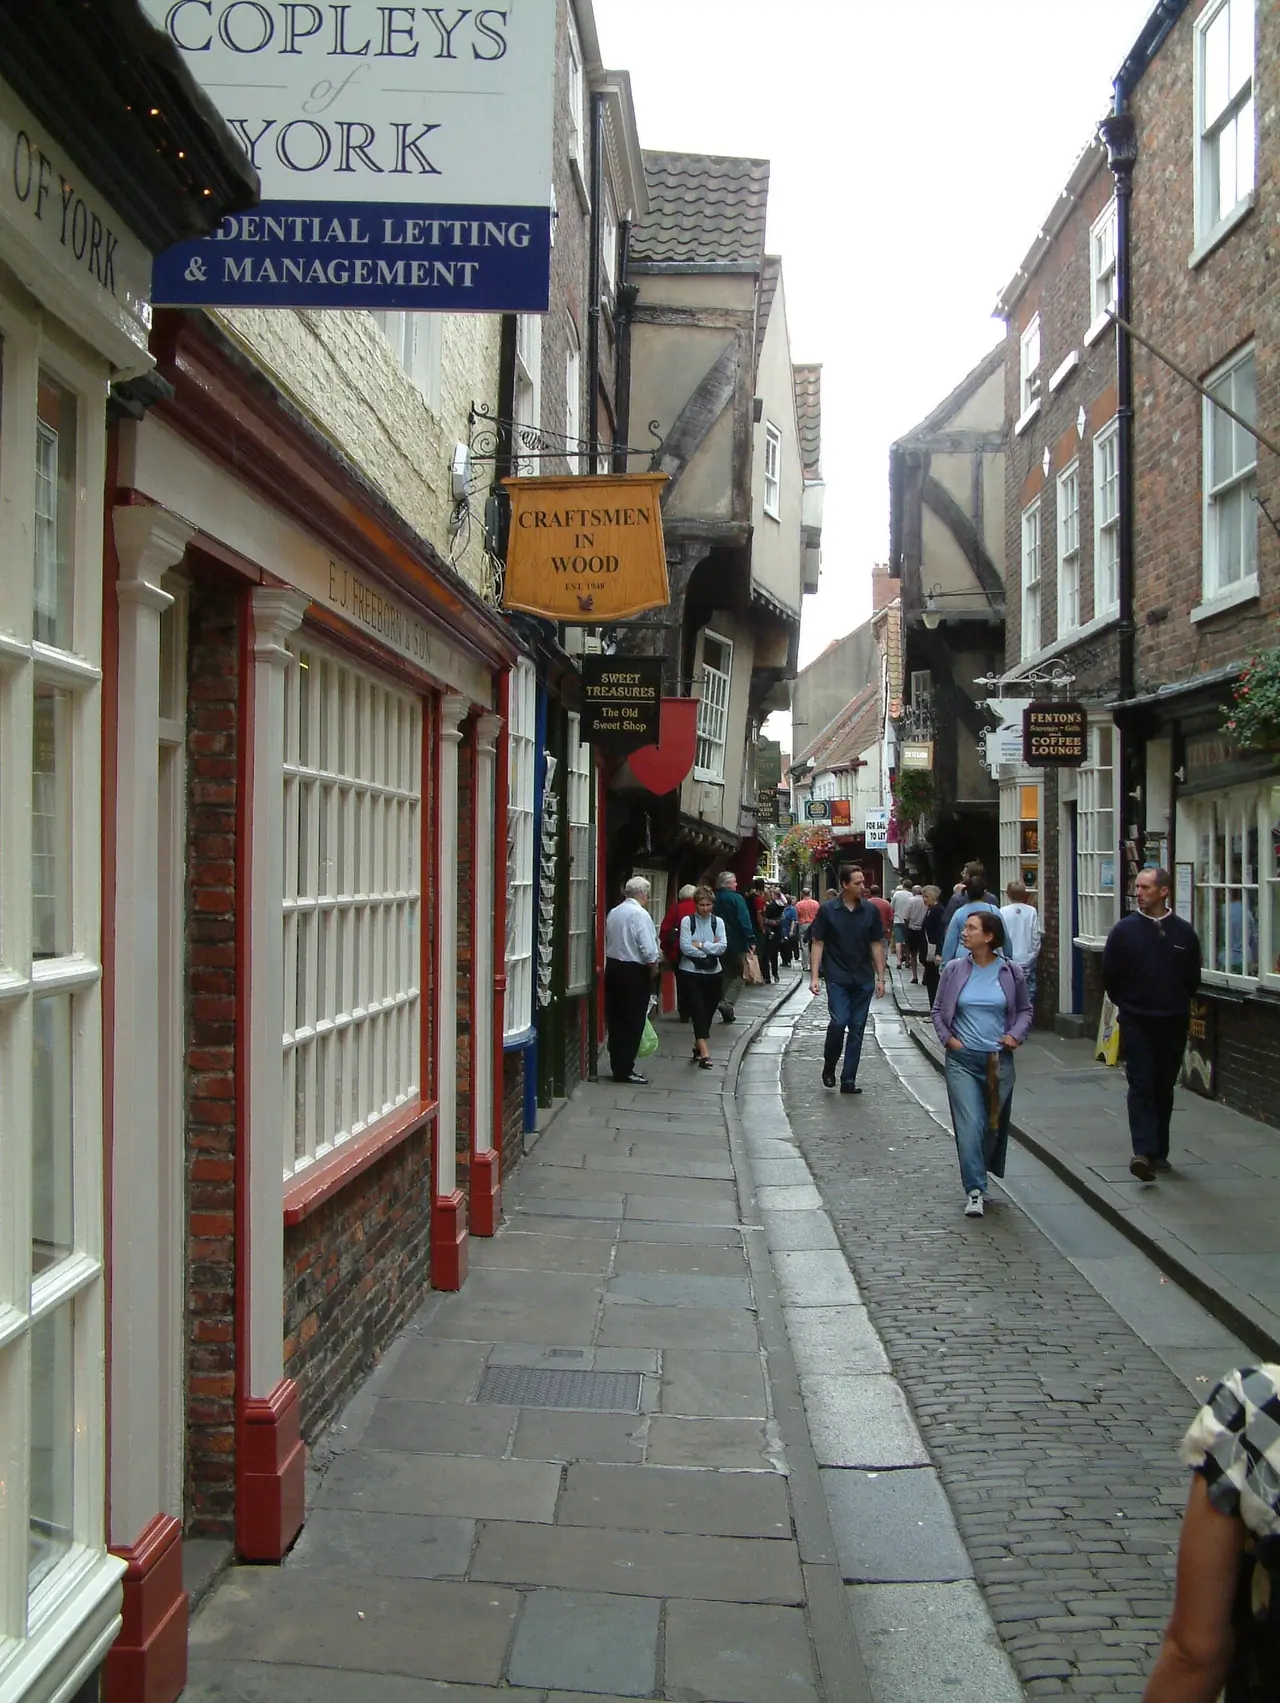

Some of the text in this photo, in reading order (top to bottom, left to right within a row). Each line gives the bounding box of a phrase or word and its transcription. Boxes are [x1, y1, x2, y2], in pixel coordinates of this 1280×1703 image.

[165, 0, 507, 60] COPLEYS
[302, 63, 371, 114] of
[226, 119, 442, 174] YORK
[14, 130, 118, 298] OF YORK
[203, 216, 532, 247] DENTIAL LETTING
[184, 256, 479, 287] & MANAGEMENT
[518, 508, 650, 528] CRAFTSMEN
[574, 533, 594, 548] IN
[551, 555, 619, 573] WOOD
[601, 673, 641, 684] SWEET
[586, 686, 655, 697] TREASURES
[602, 707, 638, 718] The Old
[1030, 712, 1082, 723] FENTON'S
[593, 720, 647, 732] Sweet Shop
[1031, 737, 1082, 745] COFFEE
[1031, 746, 1082, 755] LOUNGE
[866, 821, 886, 830] FOR SAL
[870, 832, 886, 840] TO LET
